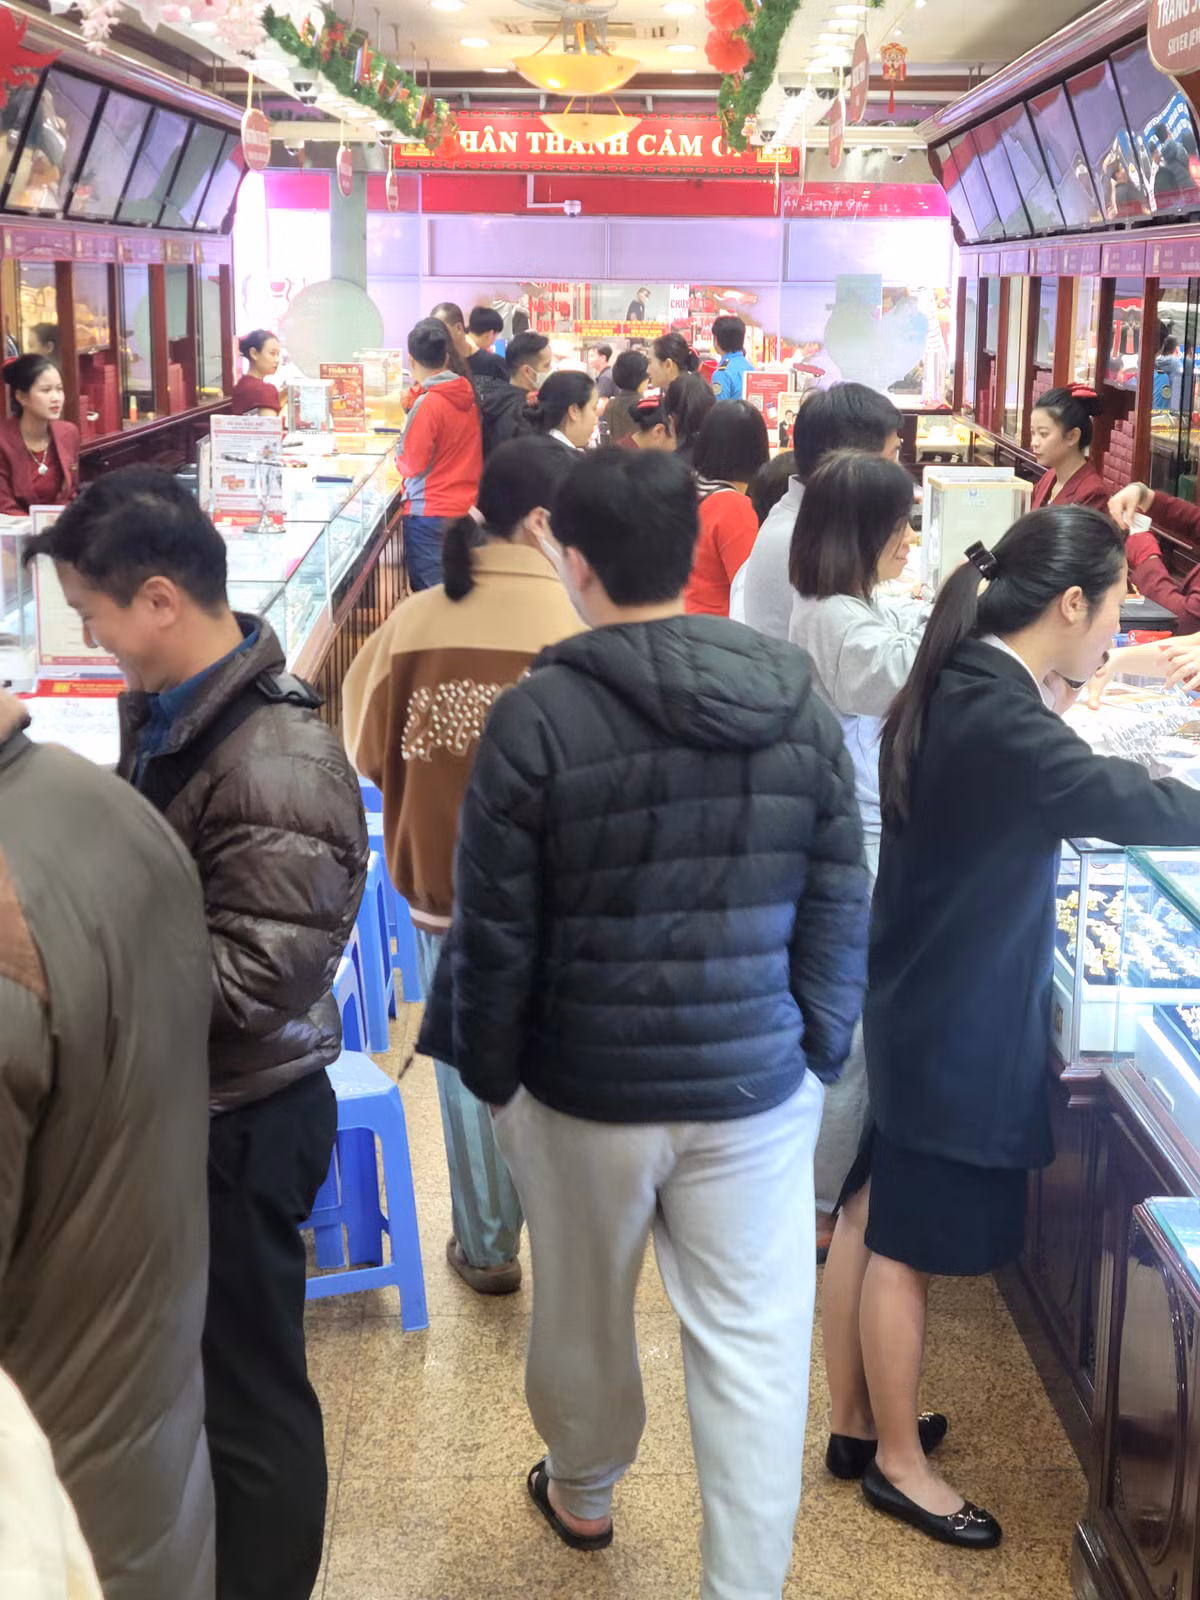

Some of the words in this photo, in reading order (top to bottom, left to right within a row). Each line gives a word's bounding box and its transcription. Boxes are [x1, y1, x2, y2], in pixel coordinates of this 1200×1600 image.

[1167, 31, 1188, 56] SILVER
[456, 125, 518, 153] HÂN
[636, 128, 703, 157] CẢM
